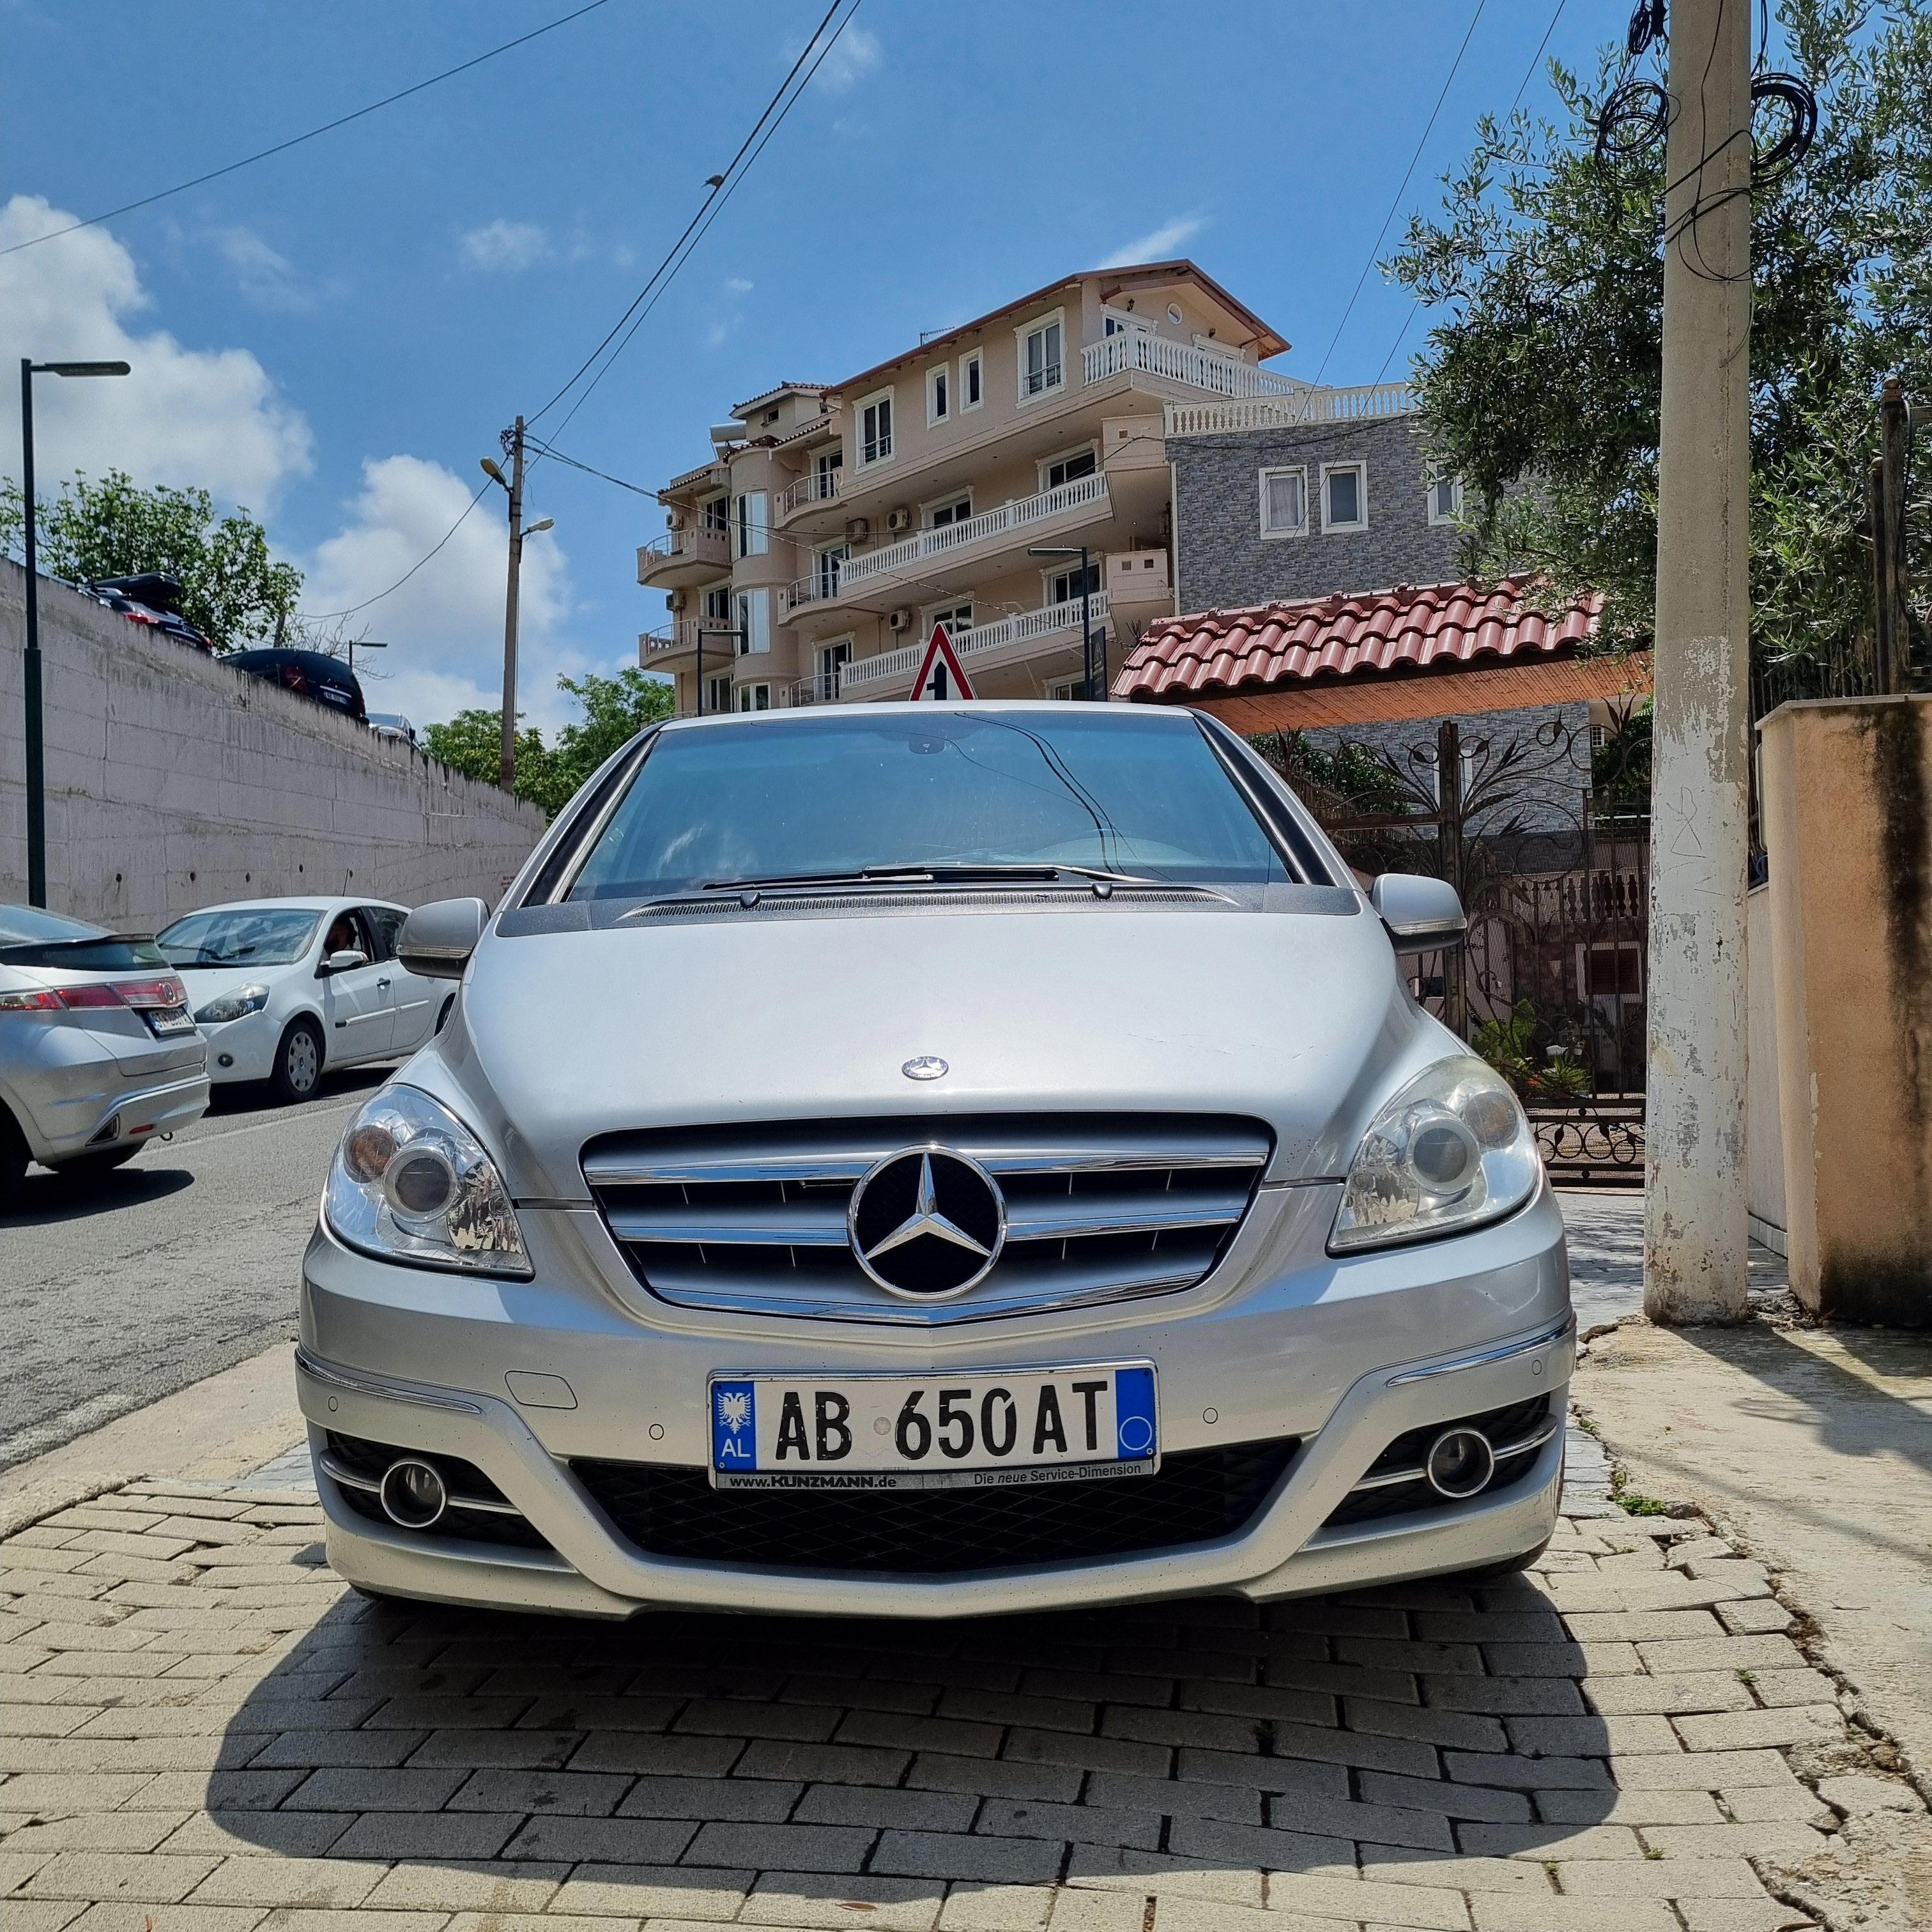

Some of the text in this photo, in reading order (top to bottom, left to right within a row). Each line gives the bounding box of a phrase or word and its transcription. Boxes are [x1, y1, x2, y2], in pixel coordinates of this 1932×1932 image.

[776, 1381, 1108, 1460] AB 650 AT
[721, 1438, 751, 1457] AL
[730, 1475, 897, 1488] www.KUNZMANN.de
[974, 1464, 1141, 1485] Die neue Service-Dimension
